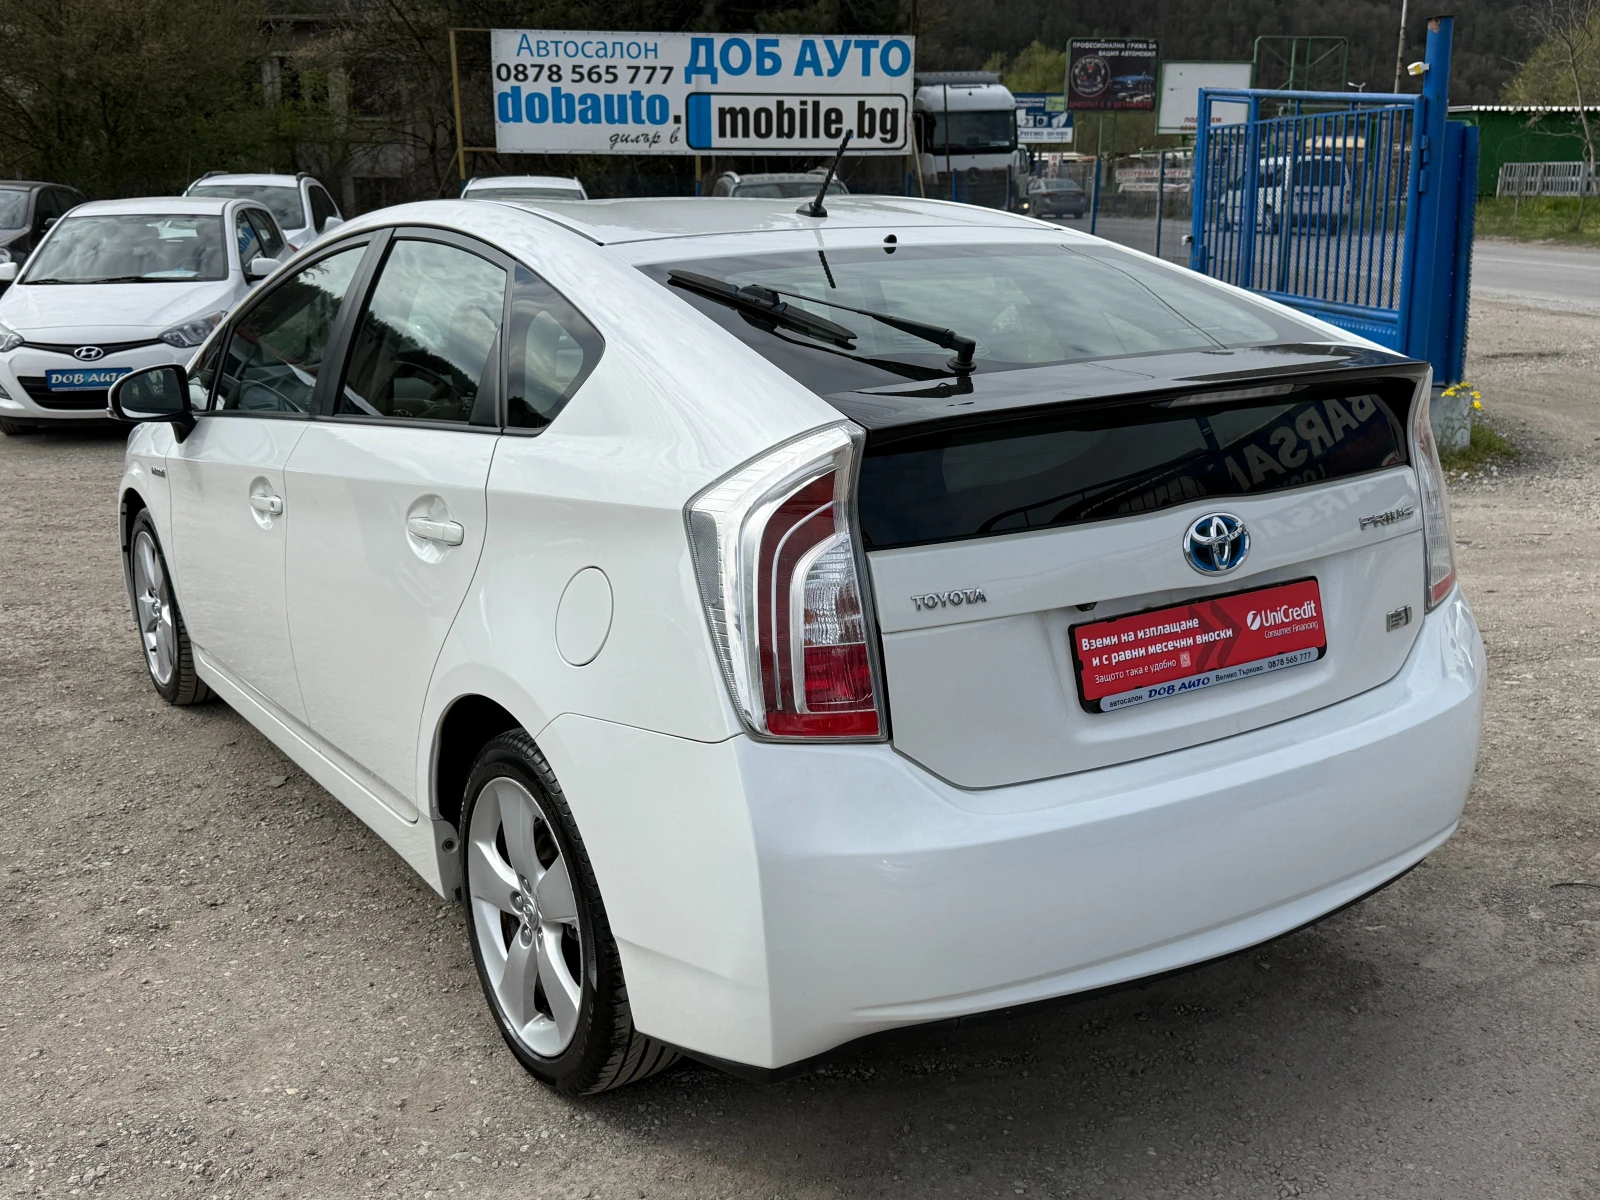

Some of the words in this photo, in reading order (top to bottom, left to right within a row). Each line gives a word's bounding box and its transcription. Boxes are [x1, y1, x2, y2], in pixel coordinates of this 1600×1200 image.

[516, 33, 658, 59] Автосалон
[496, 63, 563, 83] 0878
[571, 64, 618, 84] 565
[627, 66, 674, 85] 777
[684, 37, 782, 85] ДОБ
[794, 39, 911, 78] АУТО
[497, 85, 682, 126] dobauto.
[609, 130, 662, 150] дилър
[51, 373, 84, 385] DOB
[1358, 504, 1414, 531] PRIUS
[911, 588, 987, 611] TOYOTA
[1261, 599, 1317, 627] UniCredit
[1082, 635, 1119, 651] Вземи
[1121, 631, 1135, 643] на
[1137, 618, 1199, 640] изплащане
[1264, 627, 1292, 639] Consumer
[1292, 621, 1319, 633] Financing
[1092, 655, 1100, 667] и
[1102, 654, 1109, 665] с
[1111, 647, 1146, 666] равни
[1148, 636, 1194, 654] месечни
[1196, 628, 1233, 645] вноски
[1094, 671, 1124, 684] Защото
[1126, 666, 1143, 677] така
[1144, 665, 1149, 673] е
[1150, 658, 1177, 673] удобно
[1109, 694, 1143, 708] автосалон
[1147, 684, 1176, 698] DOB
[1178, 676, 1210, 692] AUTO
[1267, 658, 1285, 669] 0878
[1285, 655, 1298, 665] 565
[1300, 651, 1312, 661] 777
